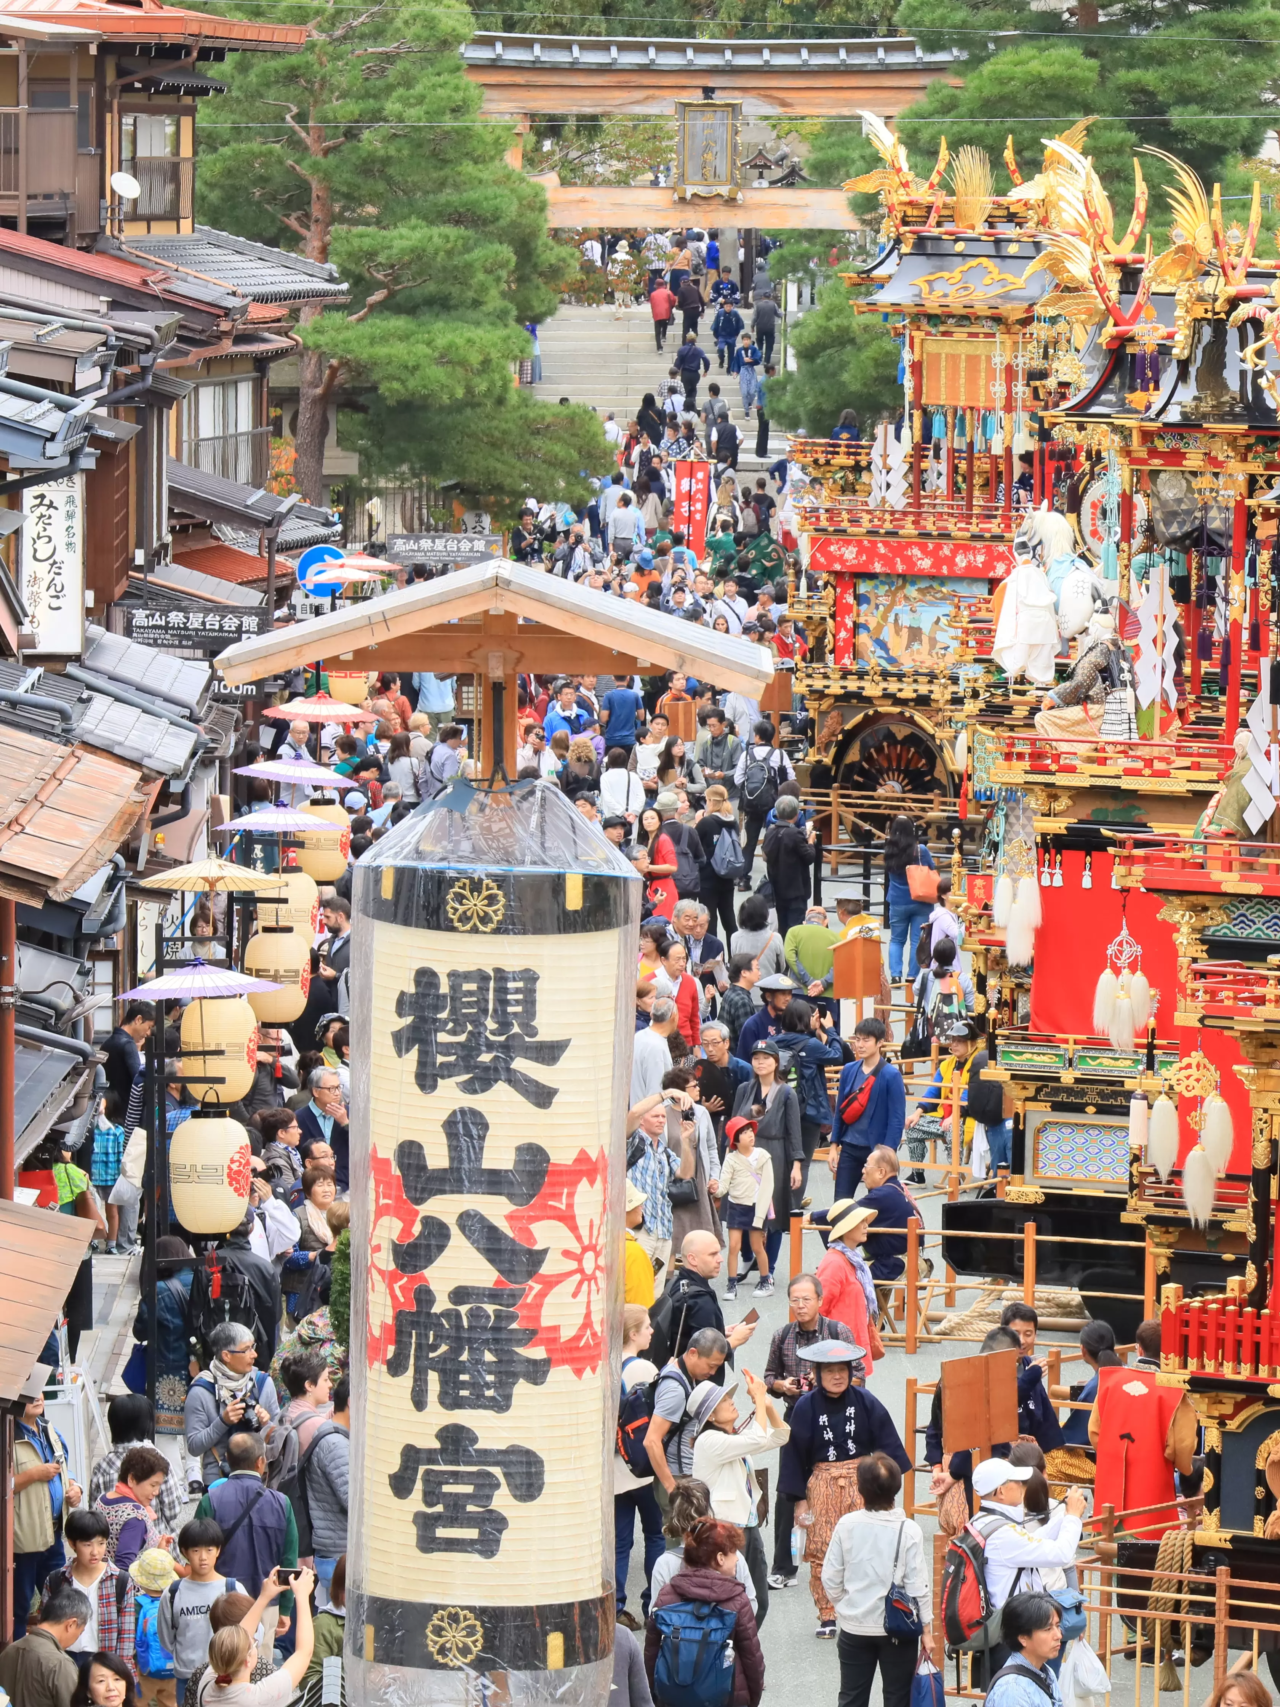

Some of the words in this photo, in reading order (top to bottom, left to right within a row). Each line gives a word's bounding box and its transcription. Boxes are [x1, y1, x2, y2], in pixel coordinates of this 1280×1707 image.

[30, 493, 67, 611] みたらしだんご
[393, 538, 486, 552] 高山祭屋台会館
[132, 609, 259, 632] 高山祭屋台会館
[212, 680, 256, 695] 100m
[386, 966, 572, 1559] 櫻山八幡宮
